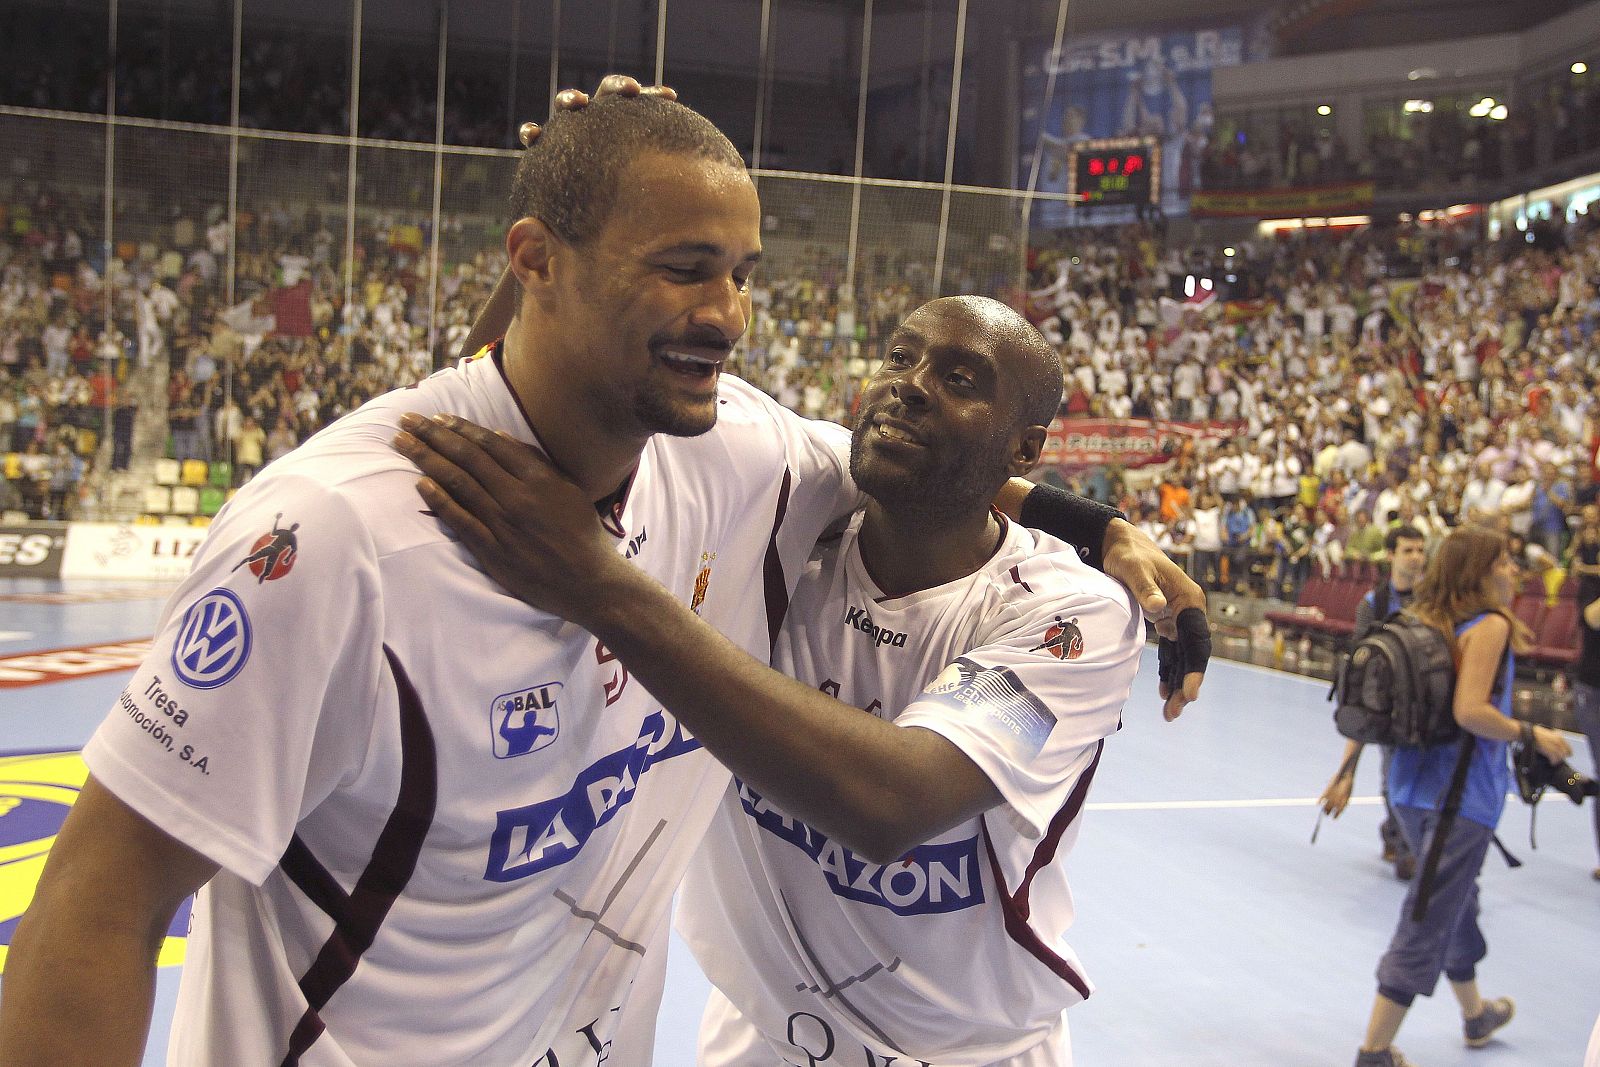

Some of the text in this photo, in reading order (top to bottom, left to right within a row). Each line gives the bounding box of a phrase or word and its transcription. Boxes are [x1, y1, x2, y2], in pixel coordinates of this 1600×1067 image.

[120, 686, 210, 775] utomoción, S.A.
[144, 674, 189, 728] Tresa
[501, 808, 580, 872] LA
